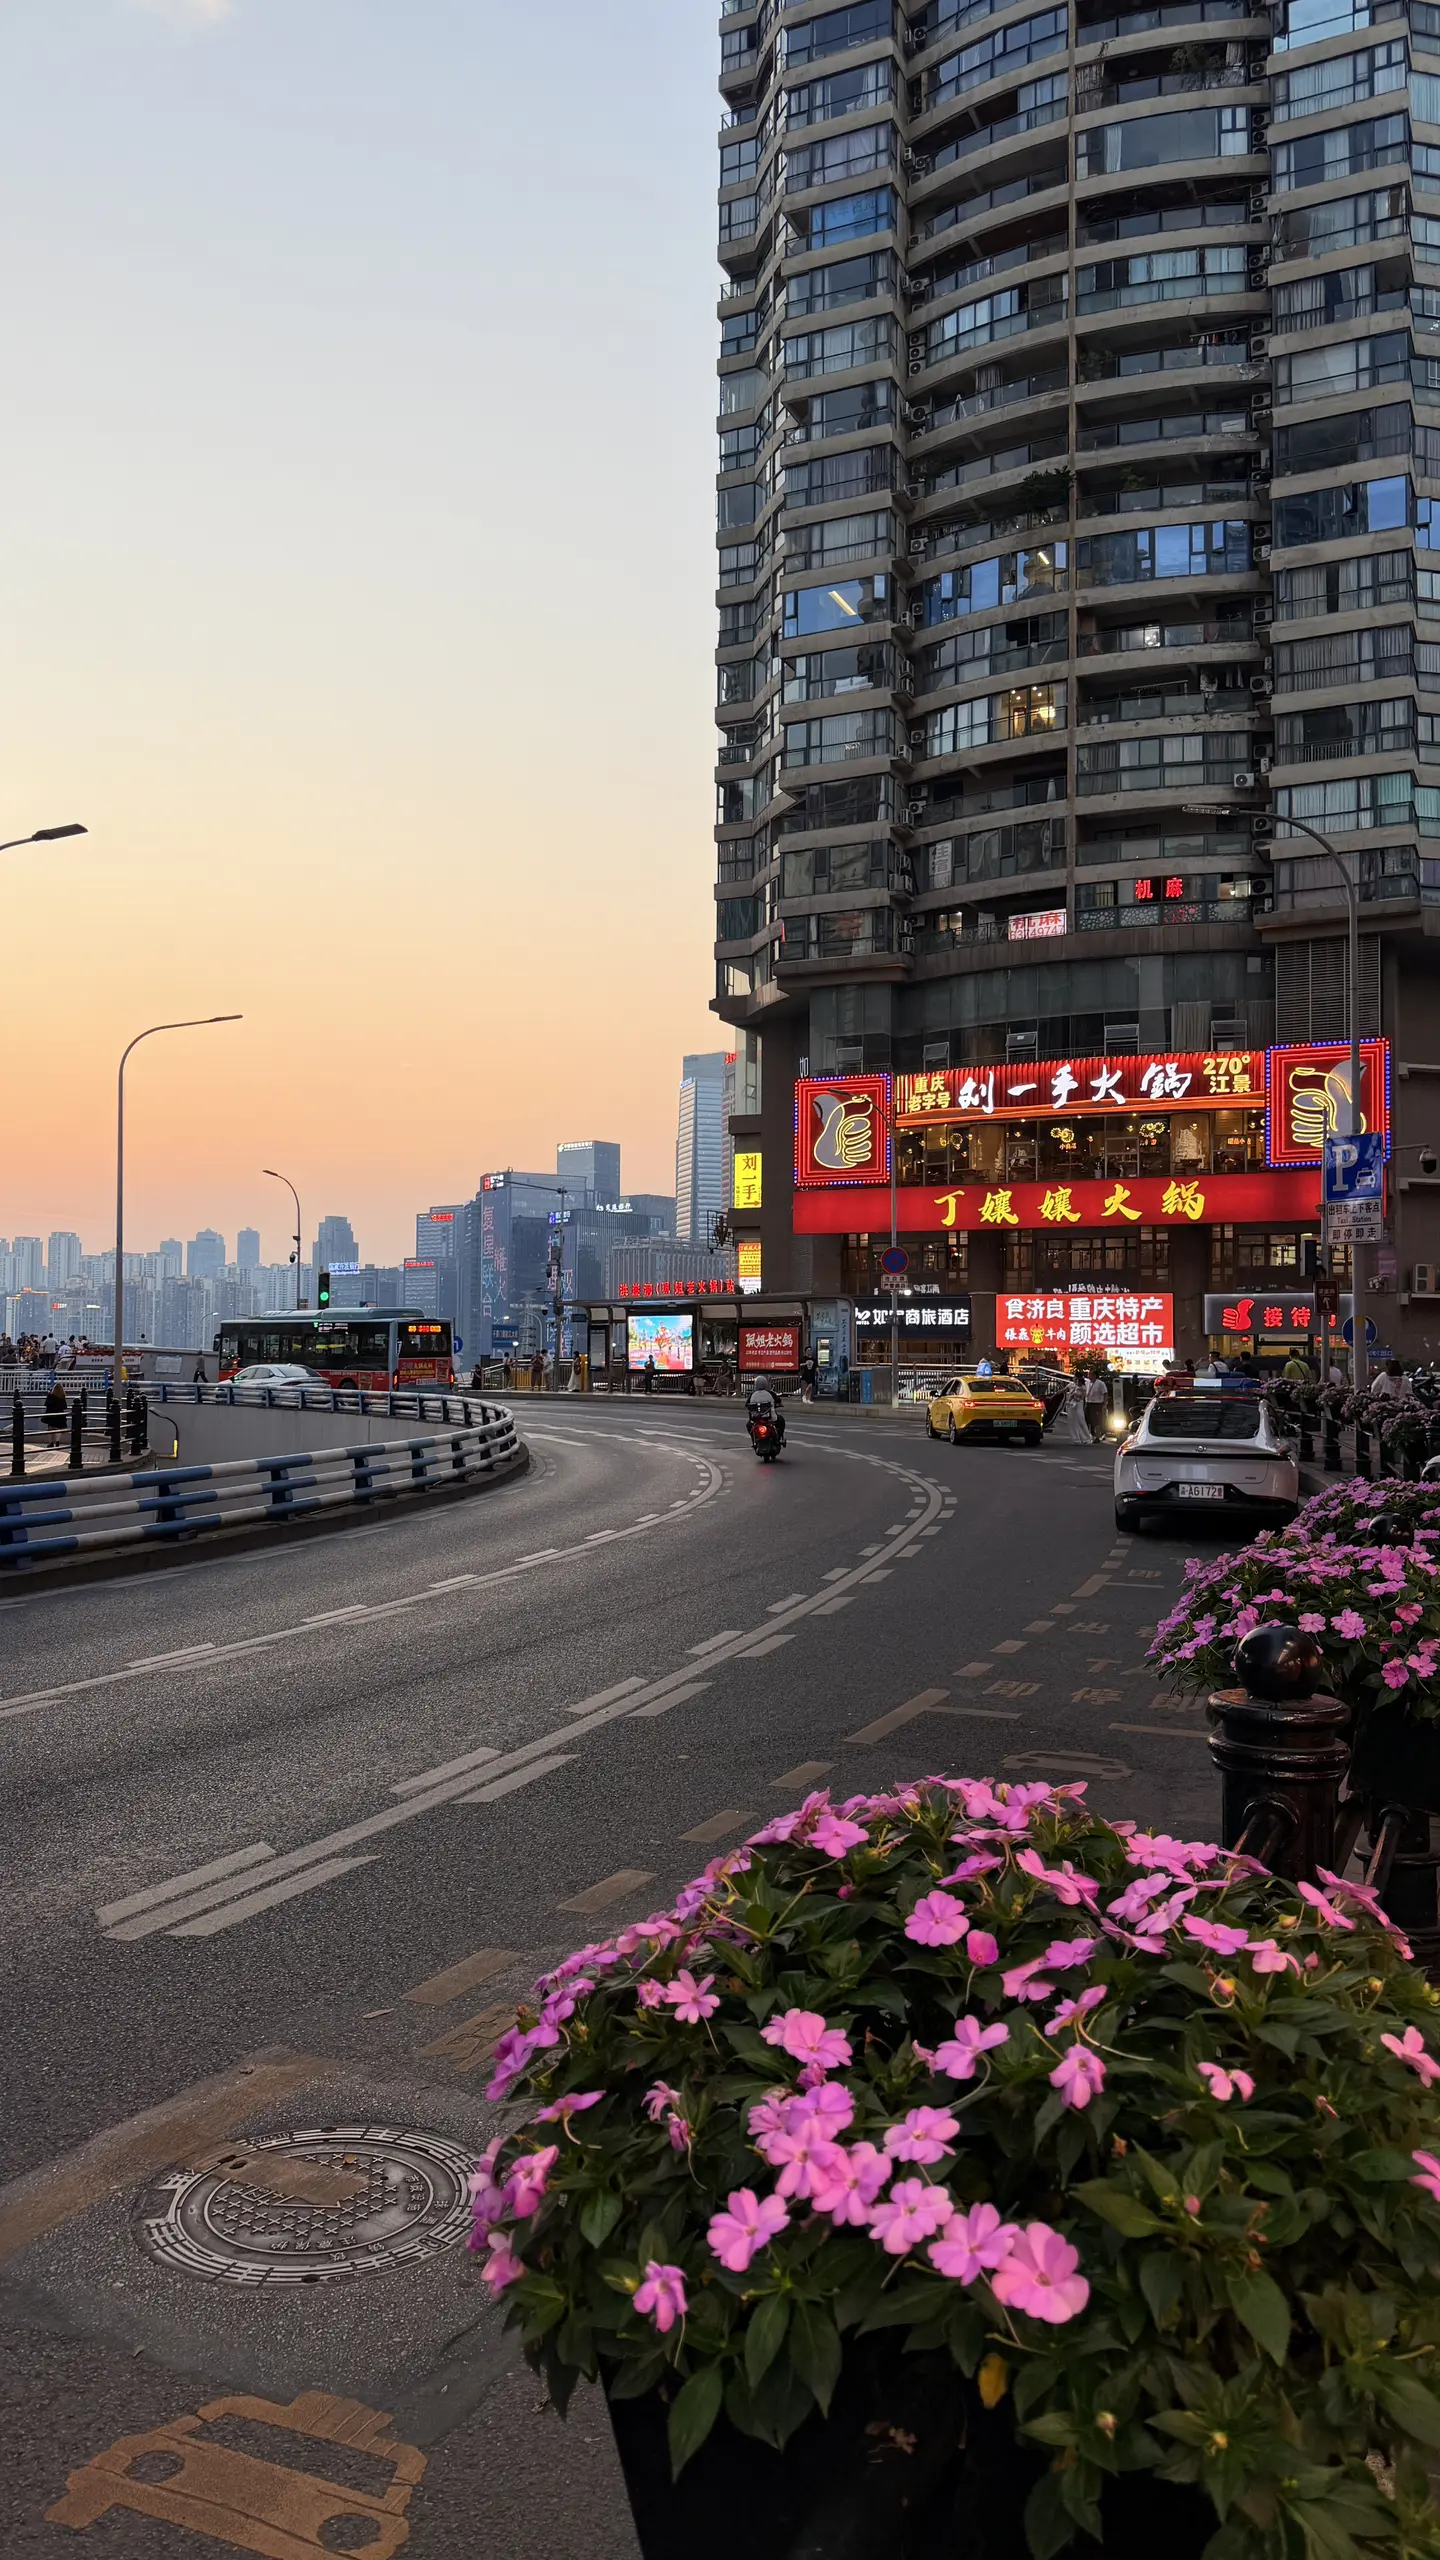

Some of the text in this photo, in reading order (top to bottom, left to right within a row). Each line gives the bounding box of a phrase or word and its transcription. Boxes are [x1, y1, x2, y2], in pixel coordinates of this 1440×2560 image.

[1135, 877, 1183, 899] 机麻
[1010, 924, 1064, 940] 6349747
[1203, 1055, 1251, 1076] 270°
[914, 1074, 945, 1094] 重庆
[1209, 1075, 1251, 1094] 江景
[908, 1091, 951, 1113] 老字号
[742, 1154, 757, 1200] 刘一手
[1331, 1143, 1358, 1192] P
[1328, 1202, 1380, 1216] 出租车上下客点
[1337, 1215, 1372, 1225] Taxi Station
[1332, 1227, 1377, 1241] 即停即走
[1004, 1298, 1065, 1320] 食济良
[1069, 1296, 1164, 1321] 重庆特产
[1263, 1306, 1337, 1328] 接待
[1069, 1321, 1165, 1346] 颜选超市
